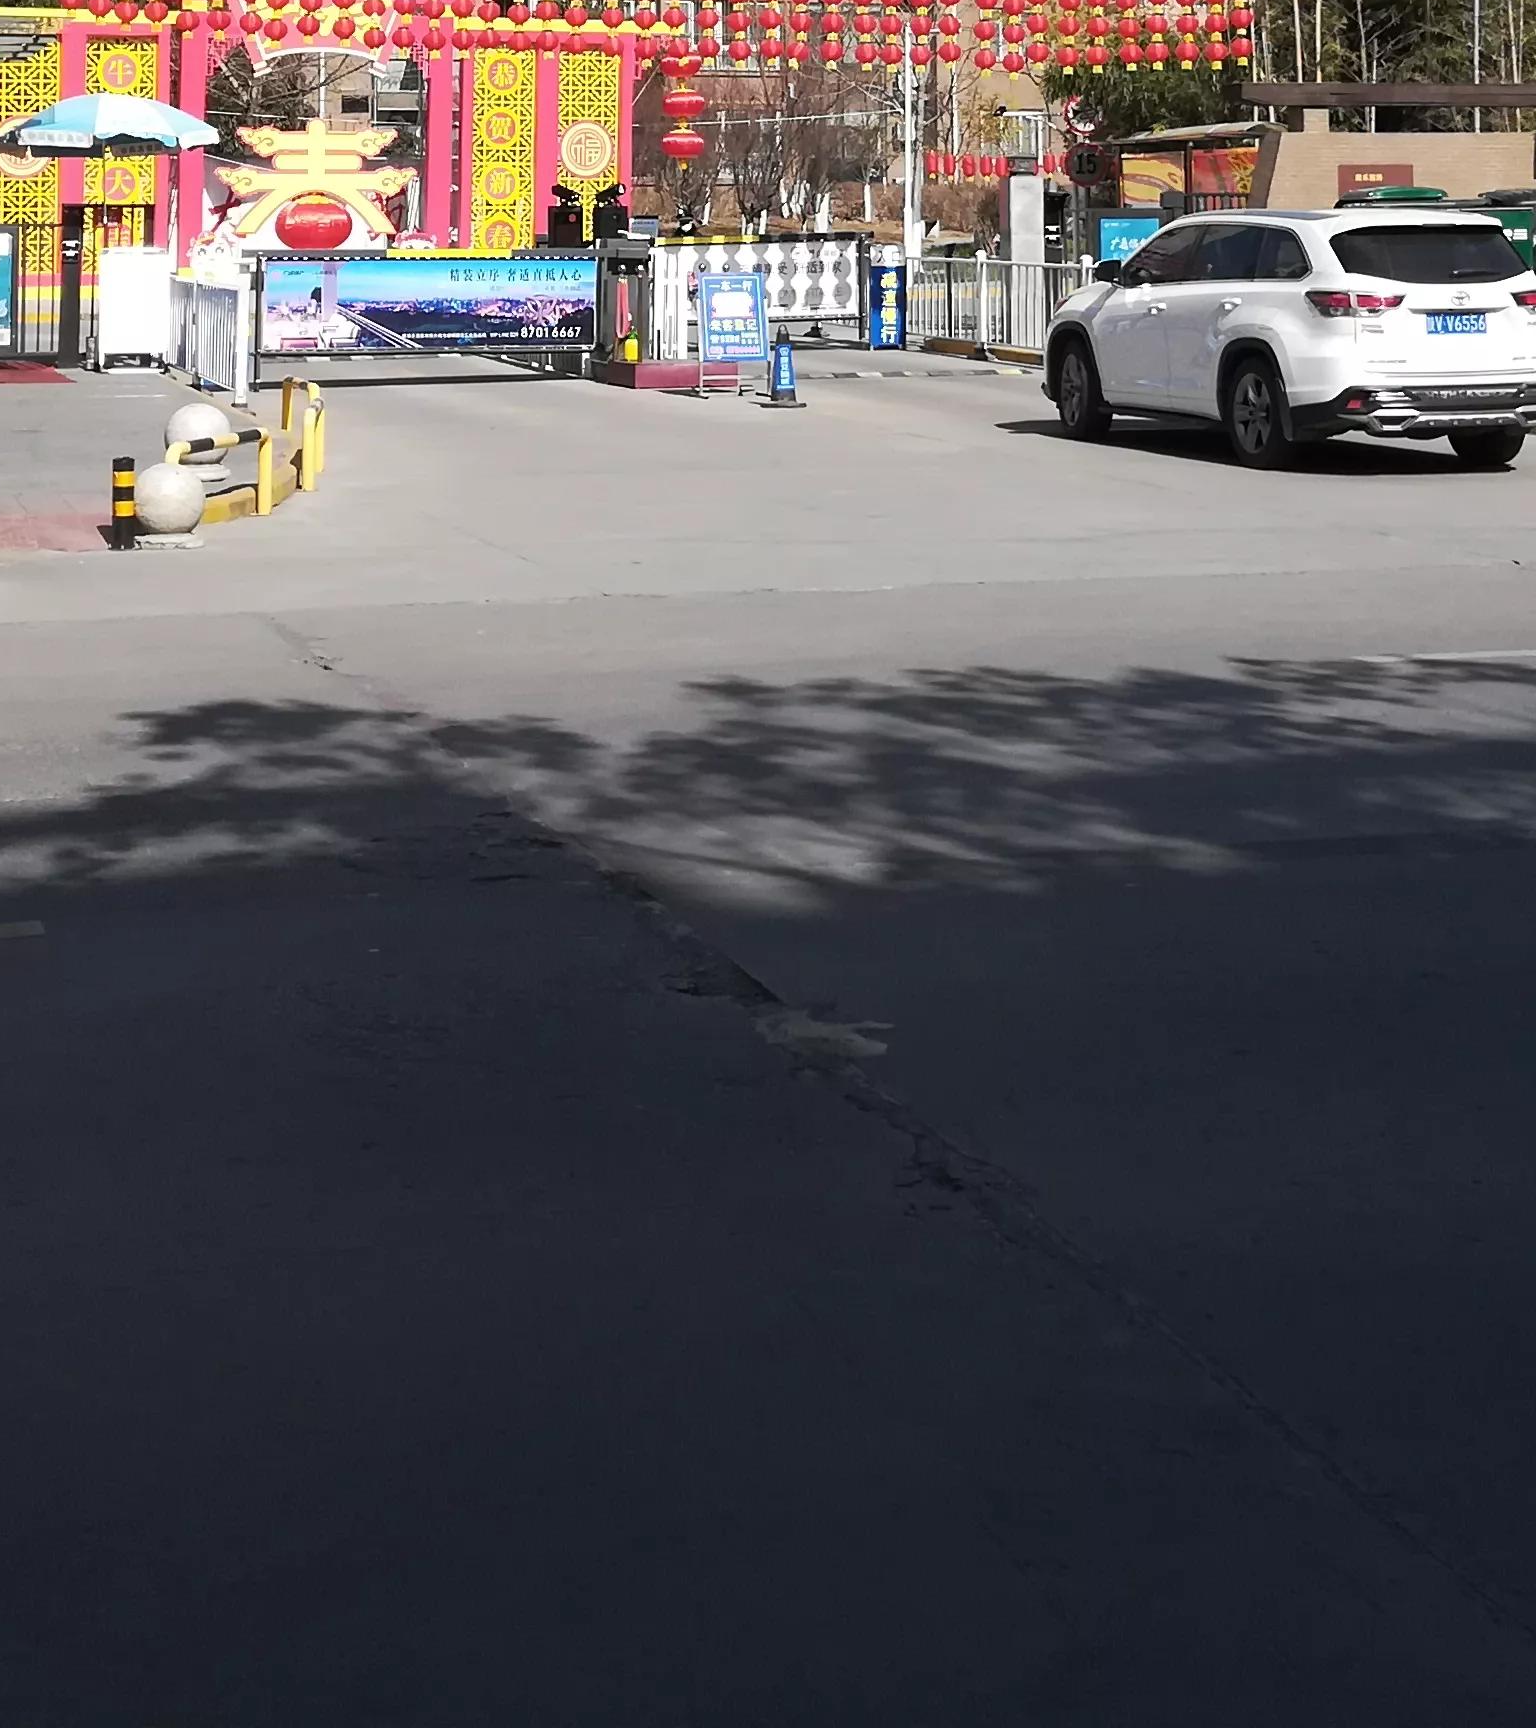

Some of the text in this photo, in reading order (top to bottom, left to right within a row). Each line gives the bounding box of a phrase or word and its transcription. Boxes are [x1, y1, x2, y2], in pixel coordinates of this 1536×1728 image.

[108, 59, 133, 86] 牛
[489, 61, 517, 248] 恭贺新春
[1075, 153, 1098, 173] 15
[449, 267, 500, 282] 精装立序
